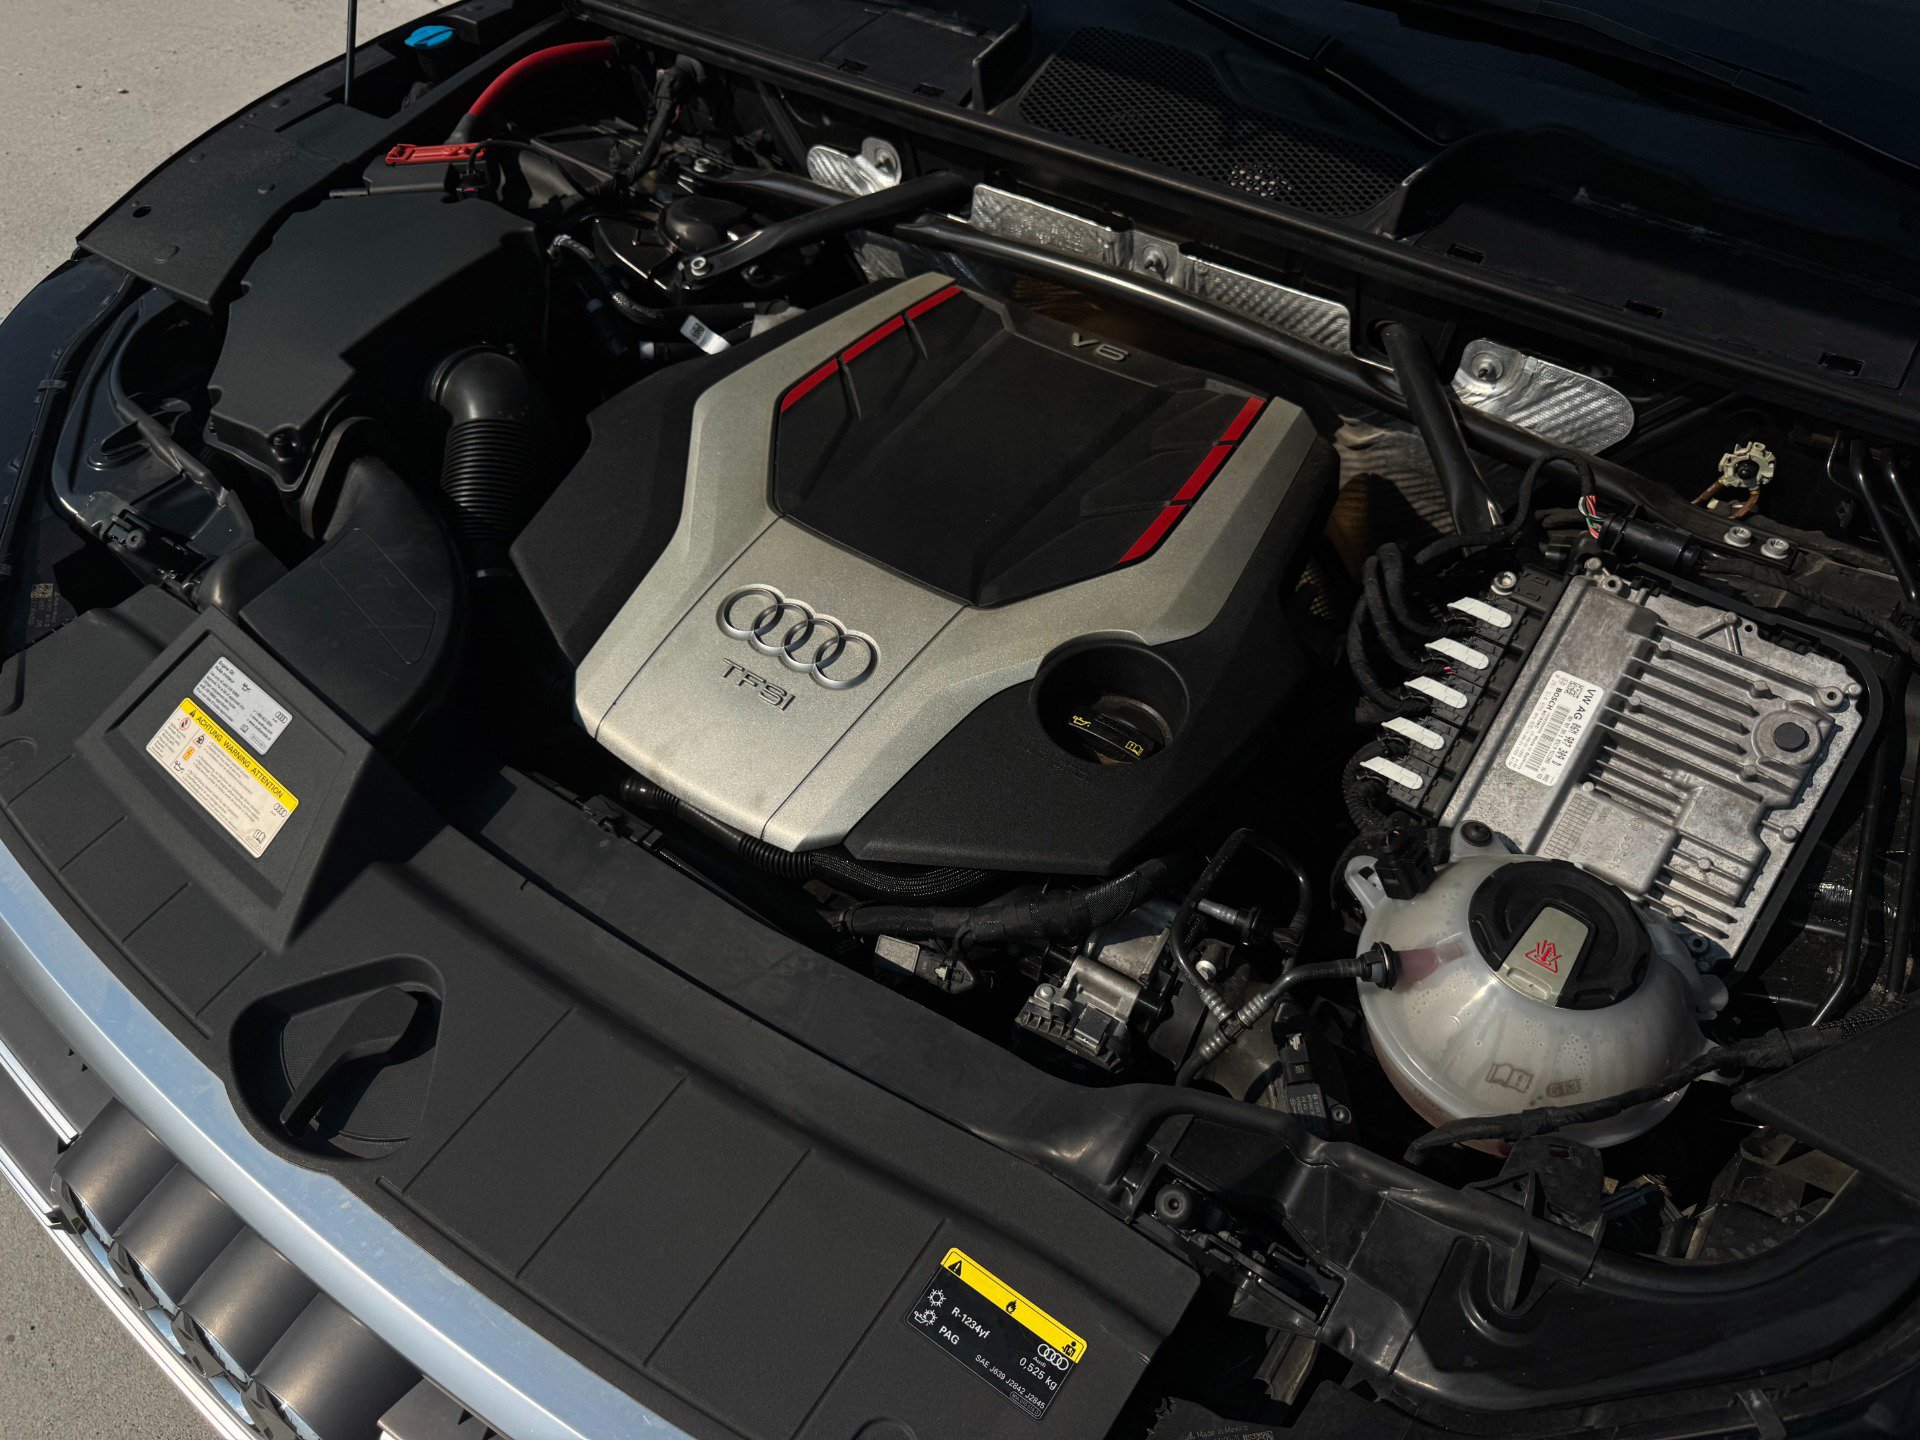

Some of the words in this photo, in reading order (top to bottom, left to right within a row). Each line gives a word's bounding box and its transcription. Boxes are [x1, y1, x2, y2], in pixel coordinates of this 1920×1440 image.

[1072, 332, 1129, 361] V6
[722, 657, 796, 711] TFSI
[1581, 688, 1597, 706] VW
[1546, 687, 1562, 711] BOSCH
[1573, 705, 1586, 721] AG
[196, 715, 223, 742] ACHTUNG
[223, 739, 250, 768] WARNING
[250, 765, 284, 799] ATTENTION
[938, 1325, 960, 1345] PAG
[951, 1306, 990, 1339] R-1234yf
[1019, 1357, 1045, 1380] 0,525
[1044, 1376, 1058, 1391] kg
[1032, 1356, 1047, 1368] Audi
[975, 1354, 990, 1368] SAE
[989, 1366, 1006, 1380] J639
[1005, 1378, 1026, 1395] J2842
[1024, 1391, 1046, 1410] J2845
